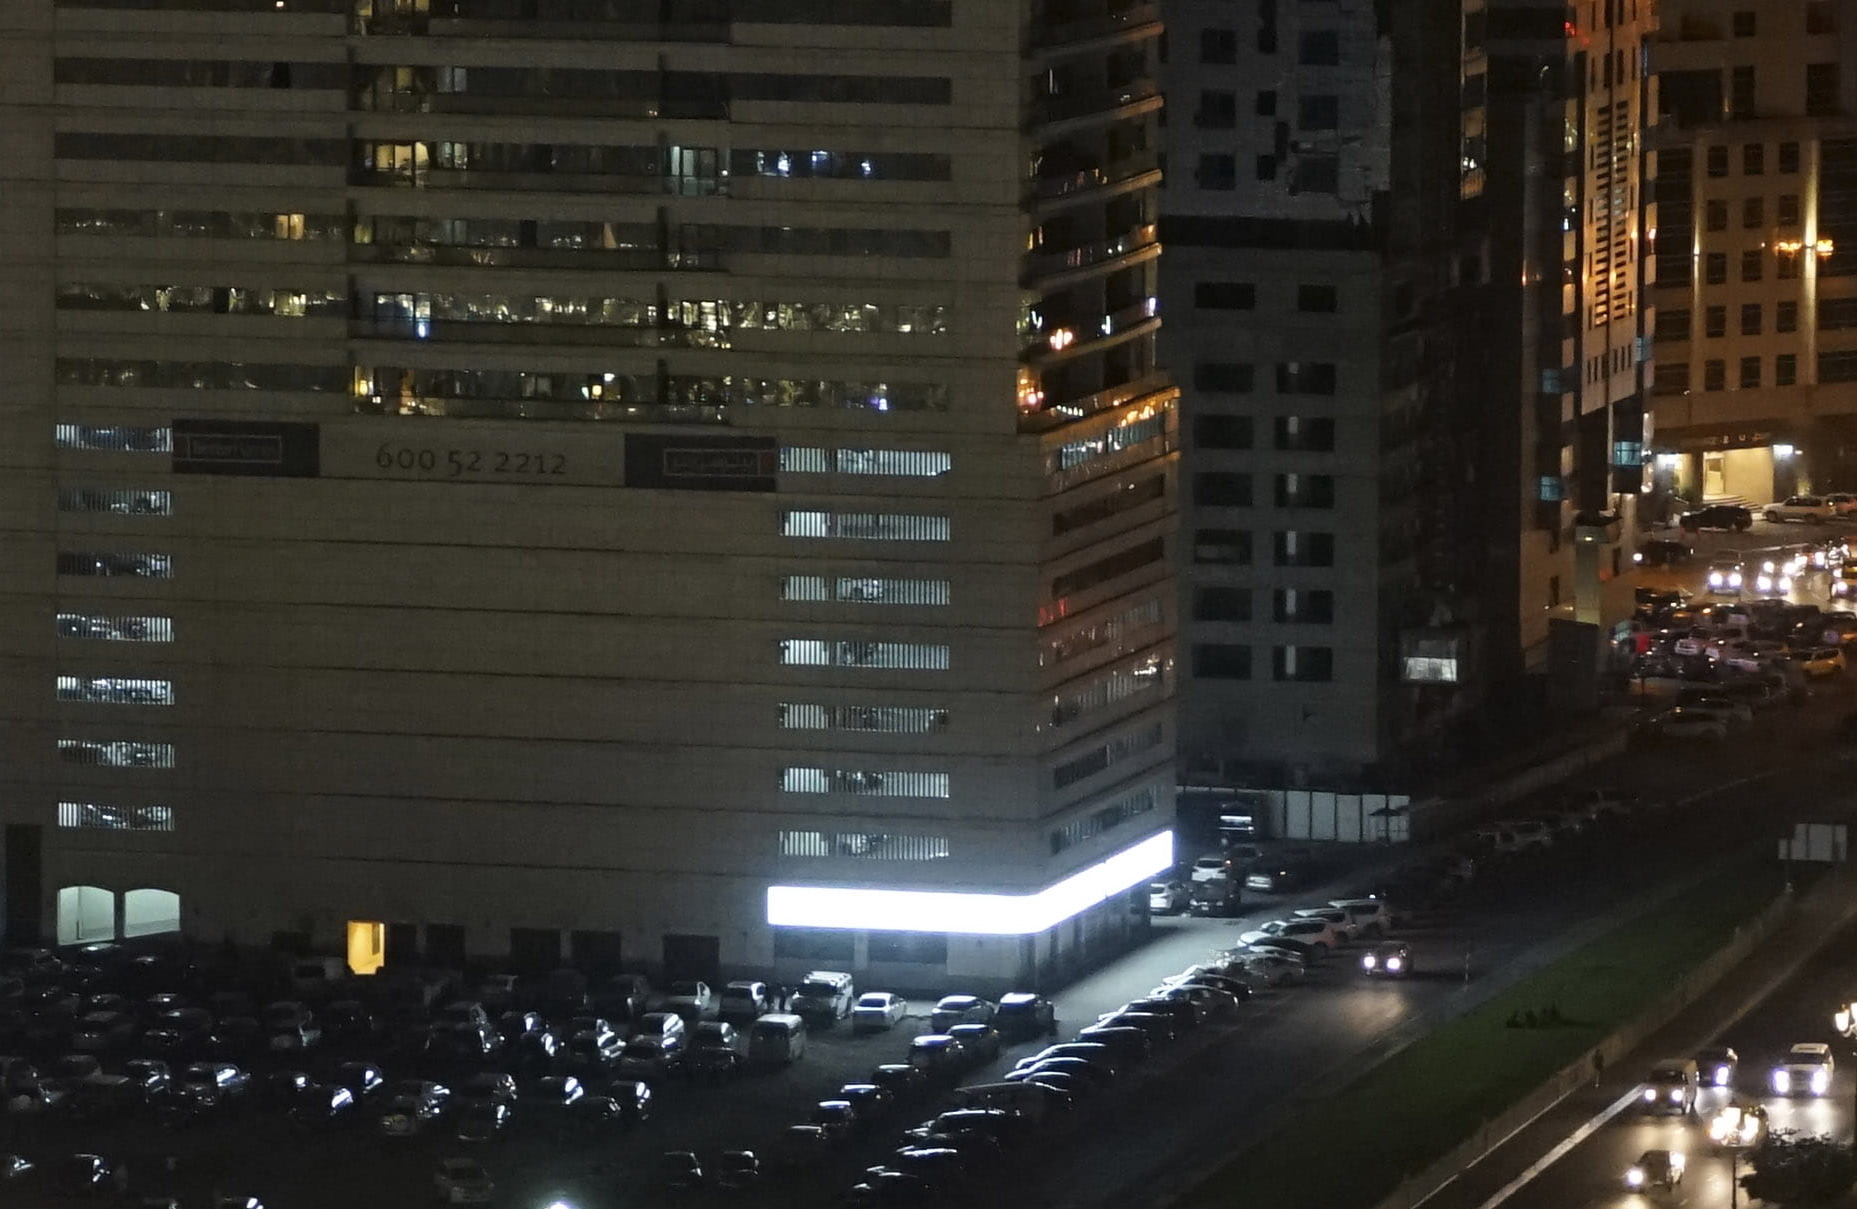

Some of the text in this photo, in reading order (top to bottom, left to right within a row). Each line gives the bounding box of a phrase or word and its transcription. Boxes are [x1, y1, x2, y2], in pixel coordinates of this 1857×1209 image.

[376, 440, 567, 477] 600 52 2212
